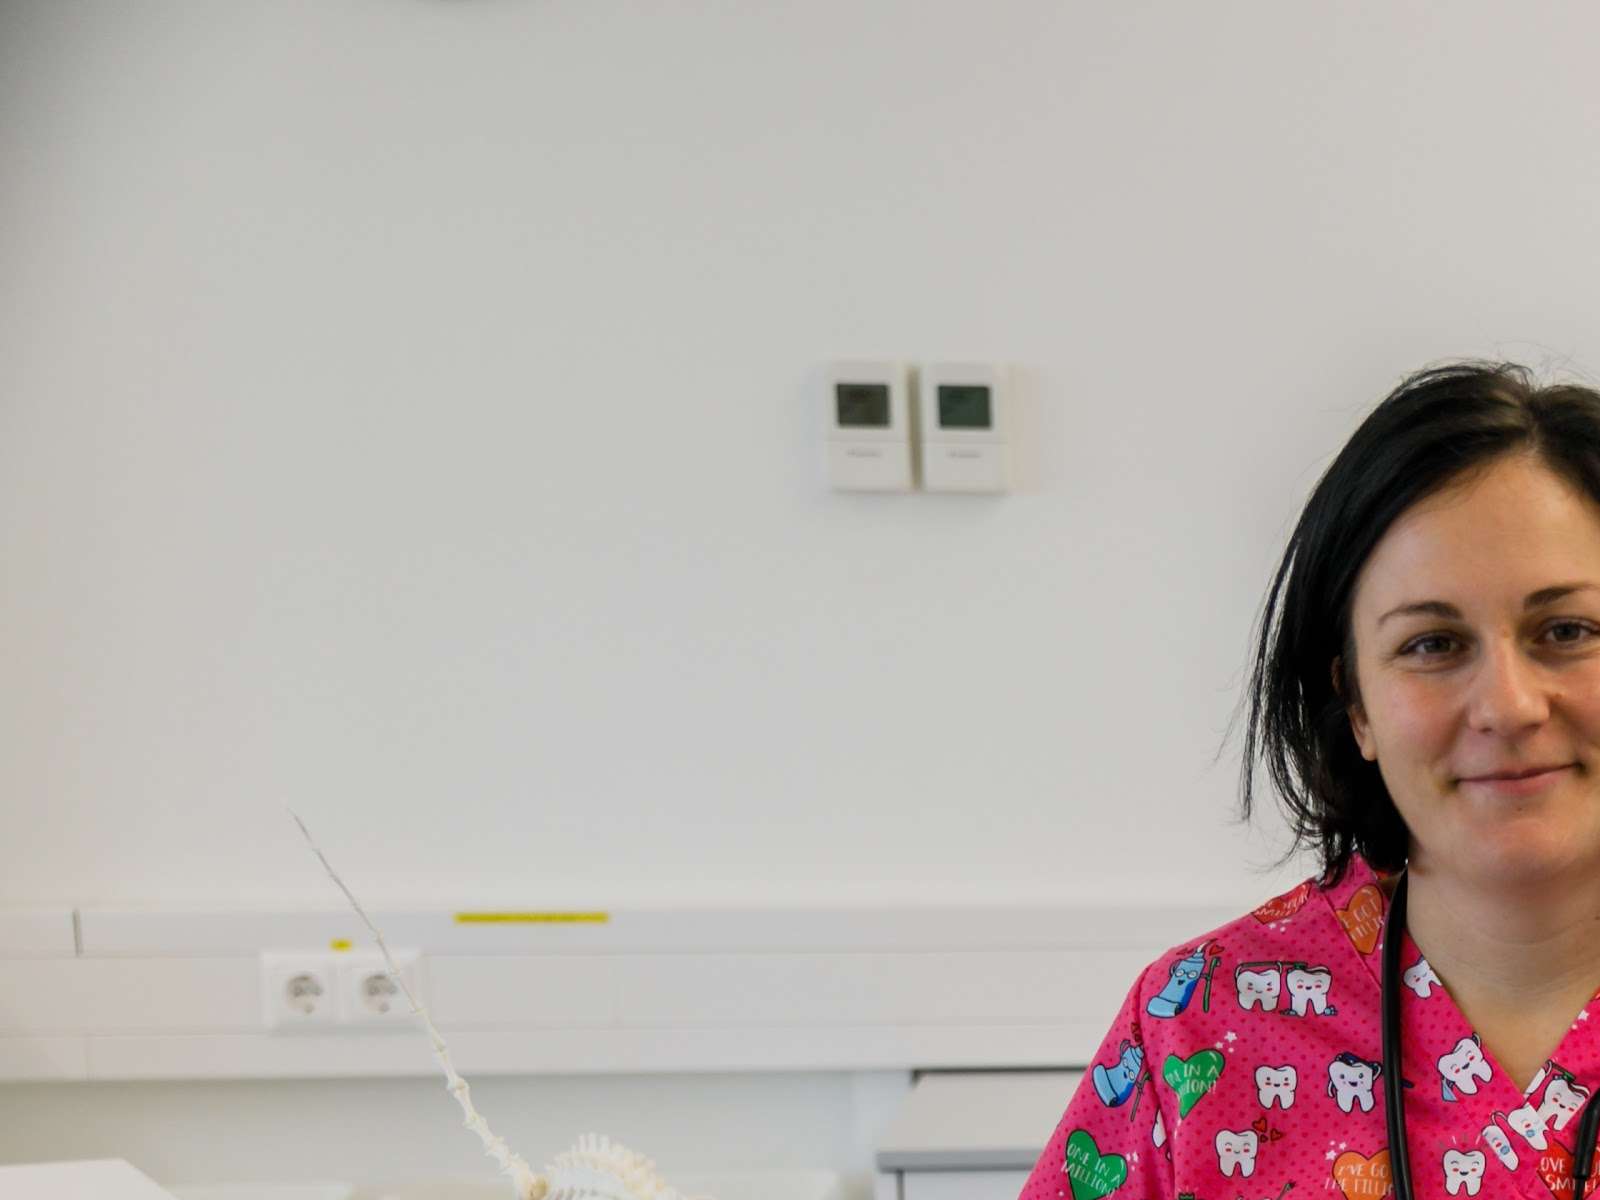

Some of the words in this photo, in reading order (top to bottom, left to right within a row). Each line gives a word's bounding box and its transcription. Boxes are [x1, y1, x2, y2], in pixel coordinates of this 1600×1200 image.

[1183, 1063, 1201, 1078] IN
[1207, 1065, 1220, 1079] A
[1067, 1142, 1090, 1167] ONE
[1095, 1157, 1111, 1178] IN
[1110, 1173, 1121, 1188] A
[1370, 1162, 1390, 1178] GO
